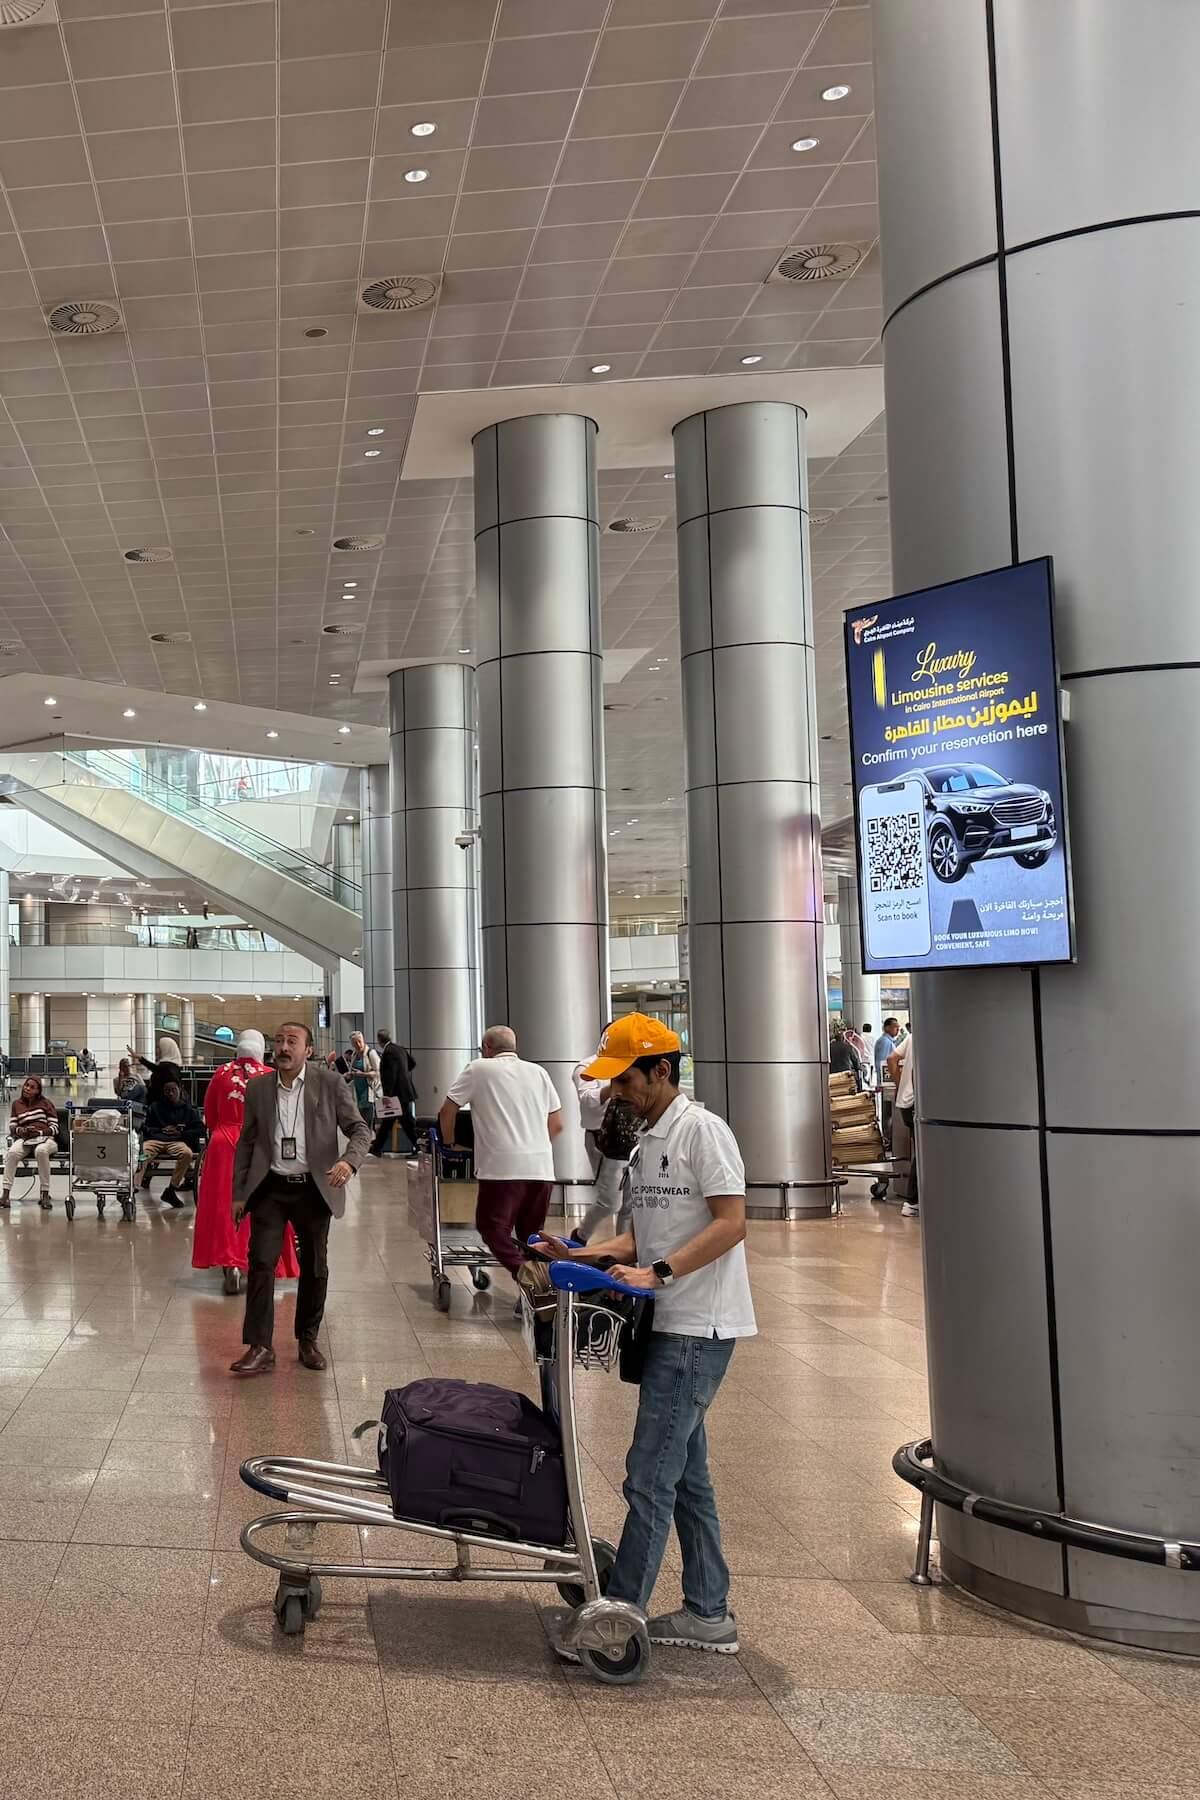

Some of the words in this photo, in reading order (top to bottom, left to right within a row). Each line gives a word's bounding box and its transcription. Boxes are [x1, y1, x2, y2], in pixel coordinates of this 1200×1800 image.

[911, 642, 977, 684] Luxury
[891, 683, 954, 706] Limousine
[956, 671, 1009, 692] services
[905, 705, 912, 713] in
[913, 702, 931, 711] Cairo
[931, 693, 978, 708] International
[978, 687, 1005, 700] Airport
[967, 690, 1038, 728] ليموزين
[884, 719, 930, 744] القاهرة
[933, 715, 967, 736] مطار
[862, 748, 908, 766] Confirm
[910, 744, 939, 760] your
[941, 730, 1013, 751] reservetion
[1016, 723, 1048, 739] here
[877, 913, 892, 922] Scan
[893, 913, 901, 921] to
[901, 911, 918, 921] book
[934, 933, 951, 942] BOOK
[951, 932, 967, 941] YOUR
[968, 930, 1003, 939] LUXURIOUS
[1003, 928, 1020, 937] LIMO
[975, 940, 991, 949] SAFE
[96, 1146, 106, 1160] 3
[640, 1185, 690, 1196] PORTSWEAR
